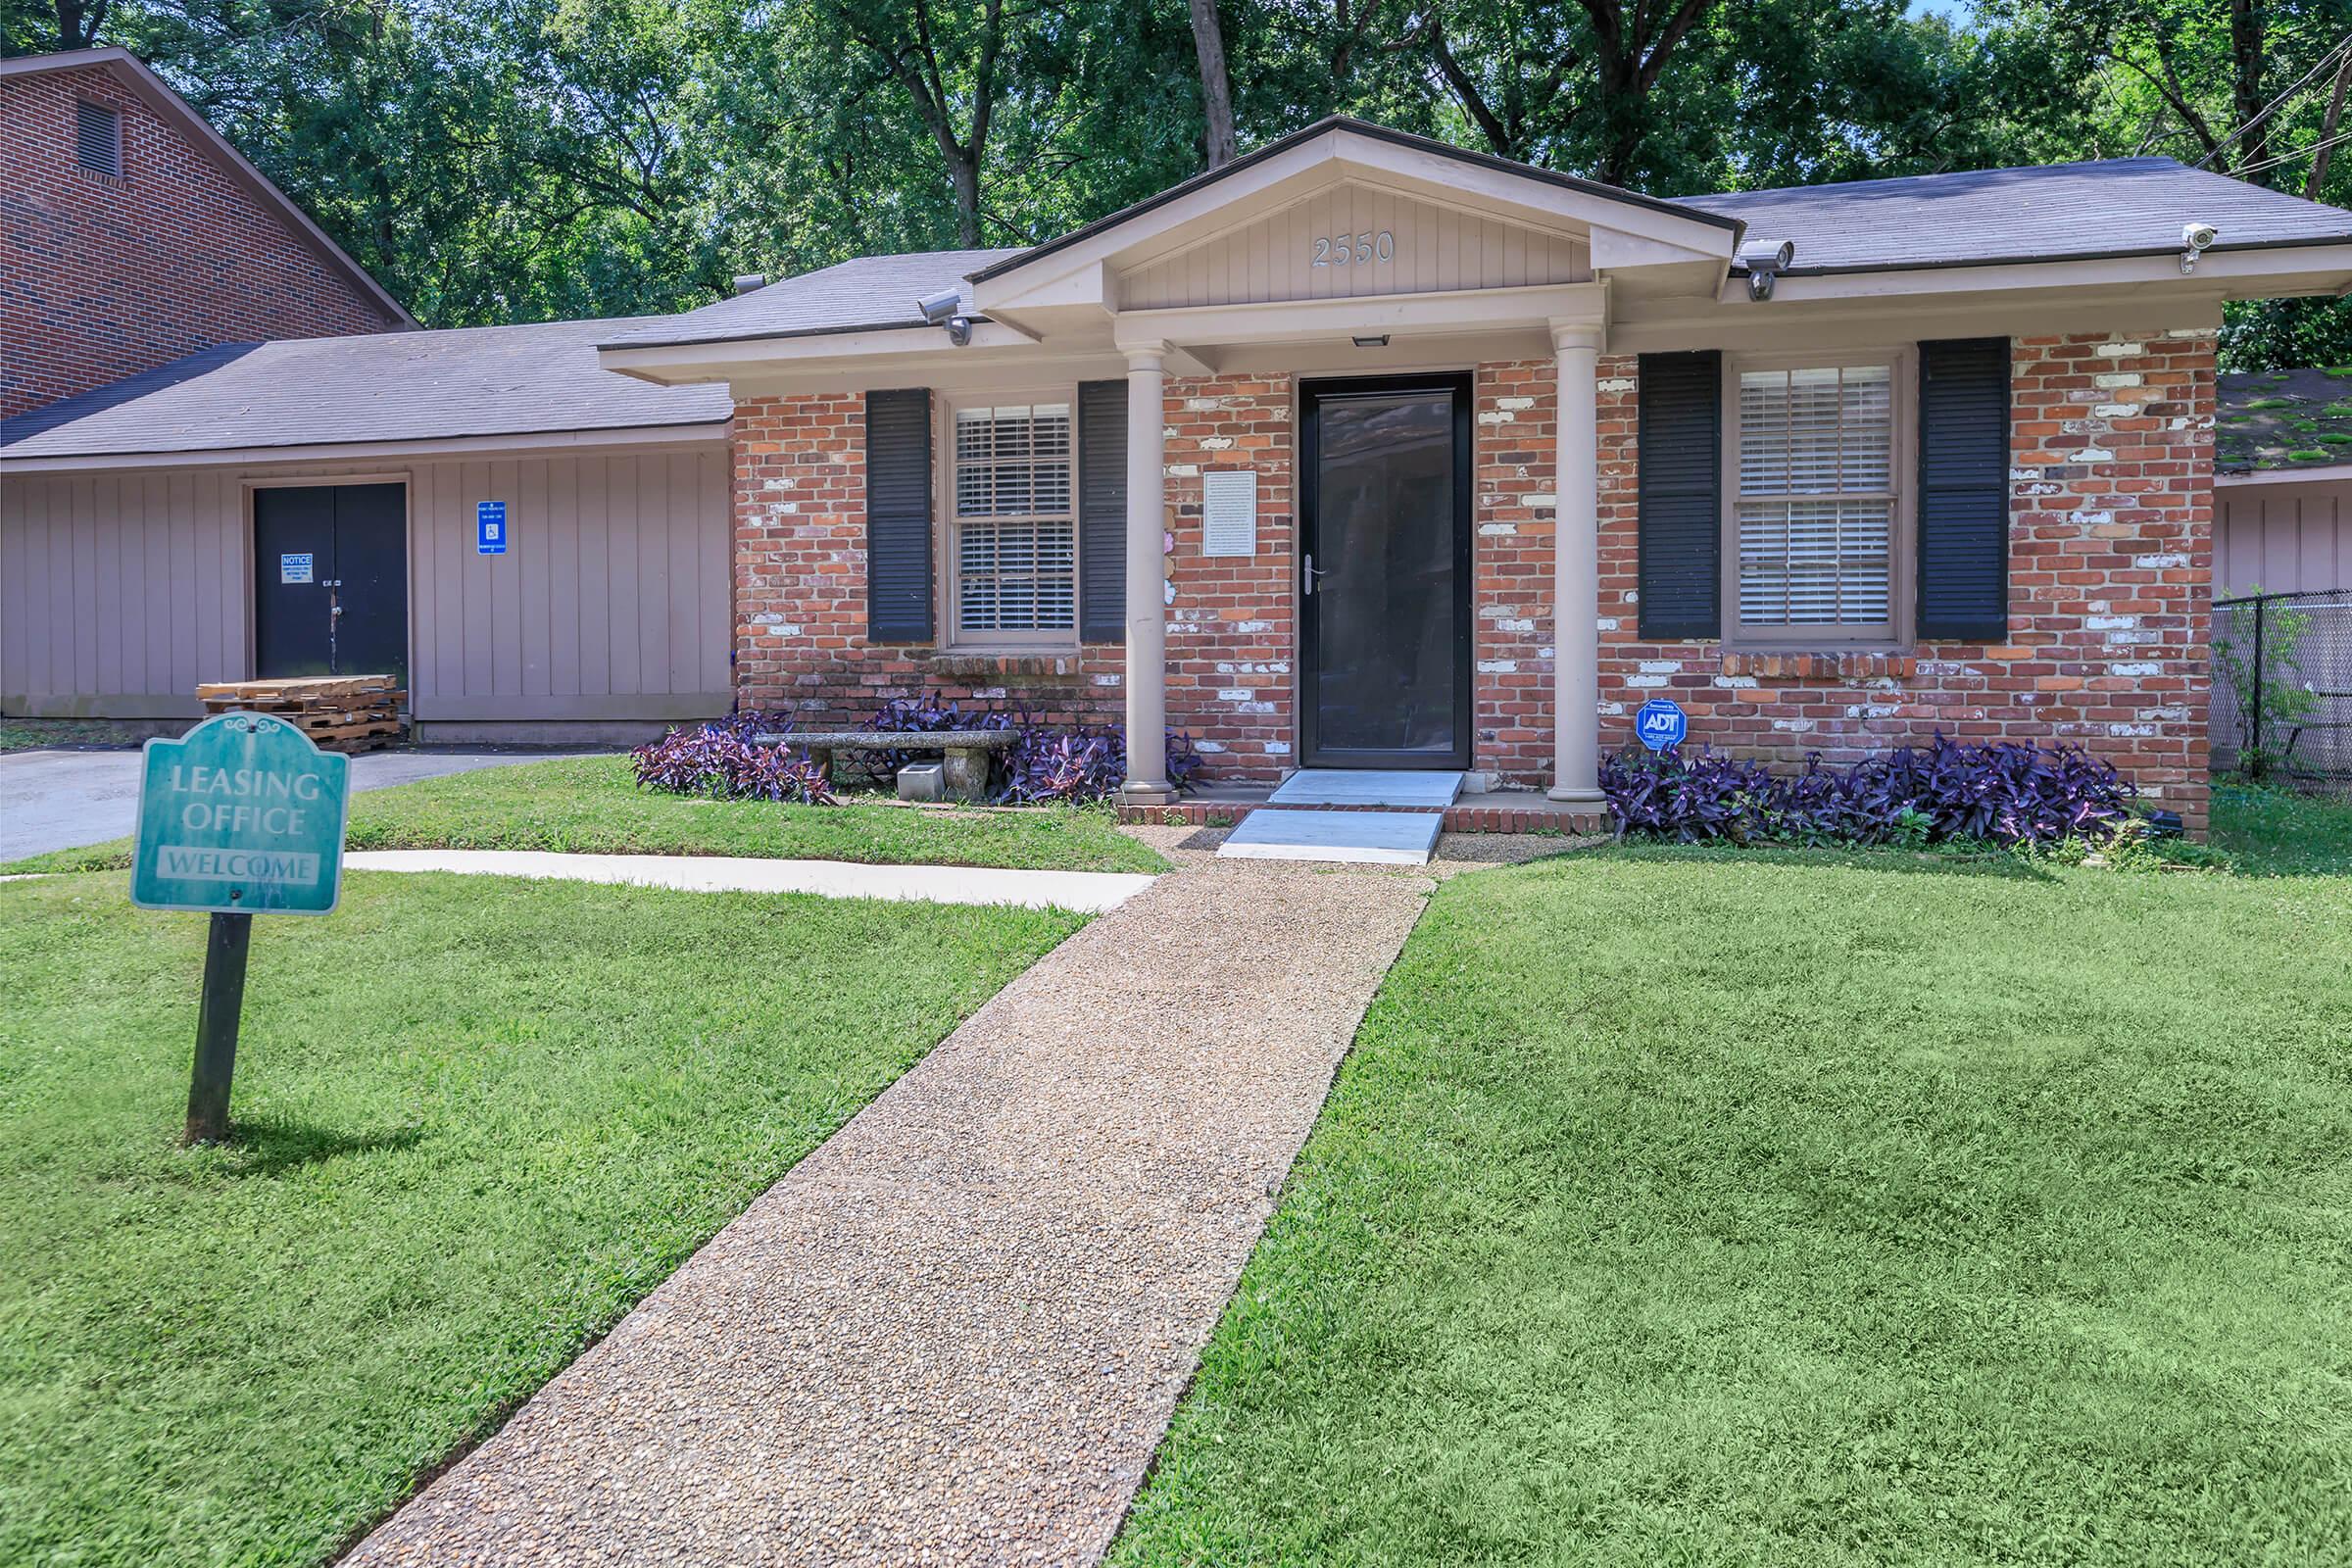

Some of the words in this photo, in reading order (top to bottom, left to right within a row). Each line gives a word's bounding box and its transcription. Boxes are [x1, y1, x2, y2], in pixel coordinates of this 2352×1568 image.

[1310, 230, 1395, 268] 2550
[283, 556, 311, 565] NOTICE
[1644, 712, 1678, 731] ADT
[172, 765, 319, 801] LEASING
[182, 803, 306, 835] OFFICE
[168, 852, 312, 879] WELCOME
